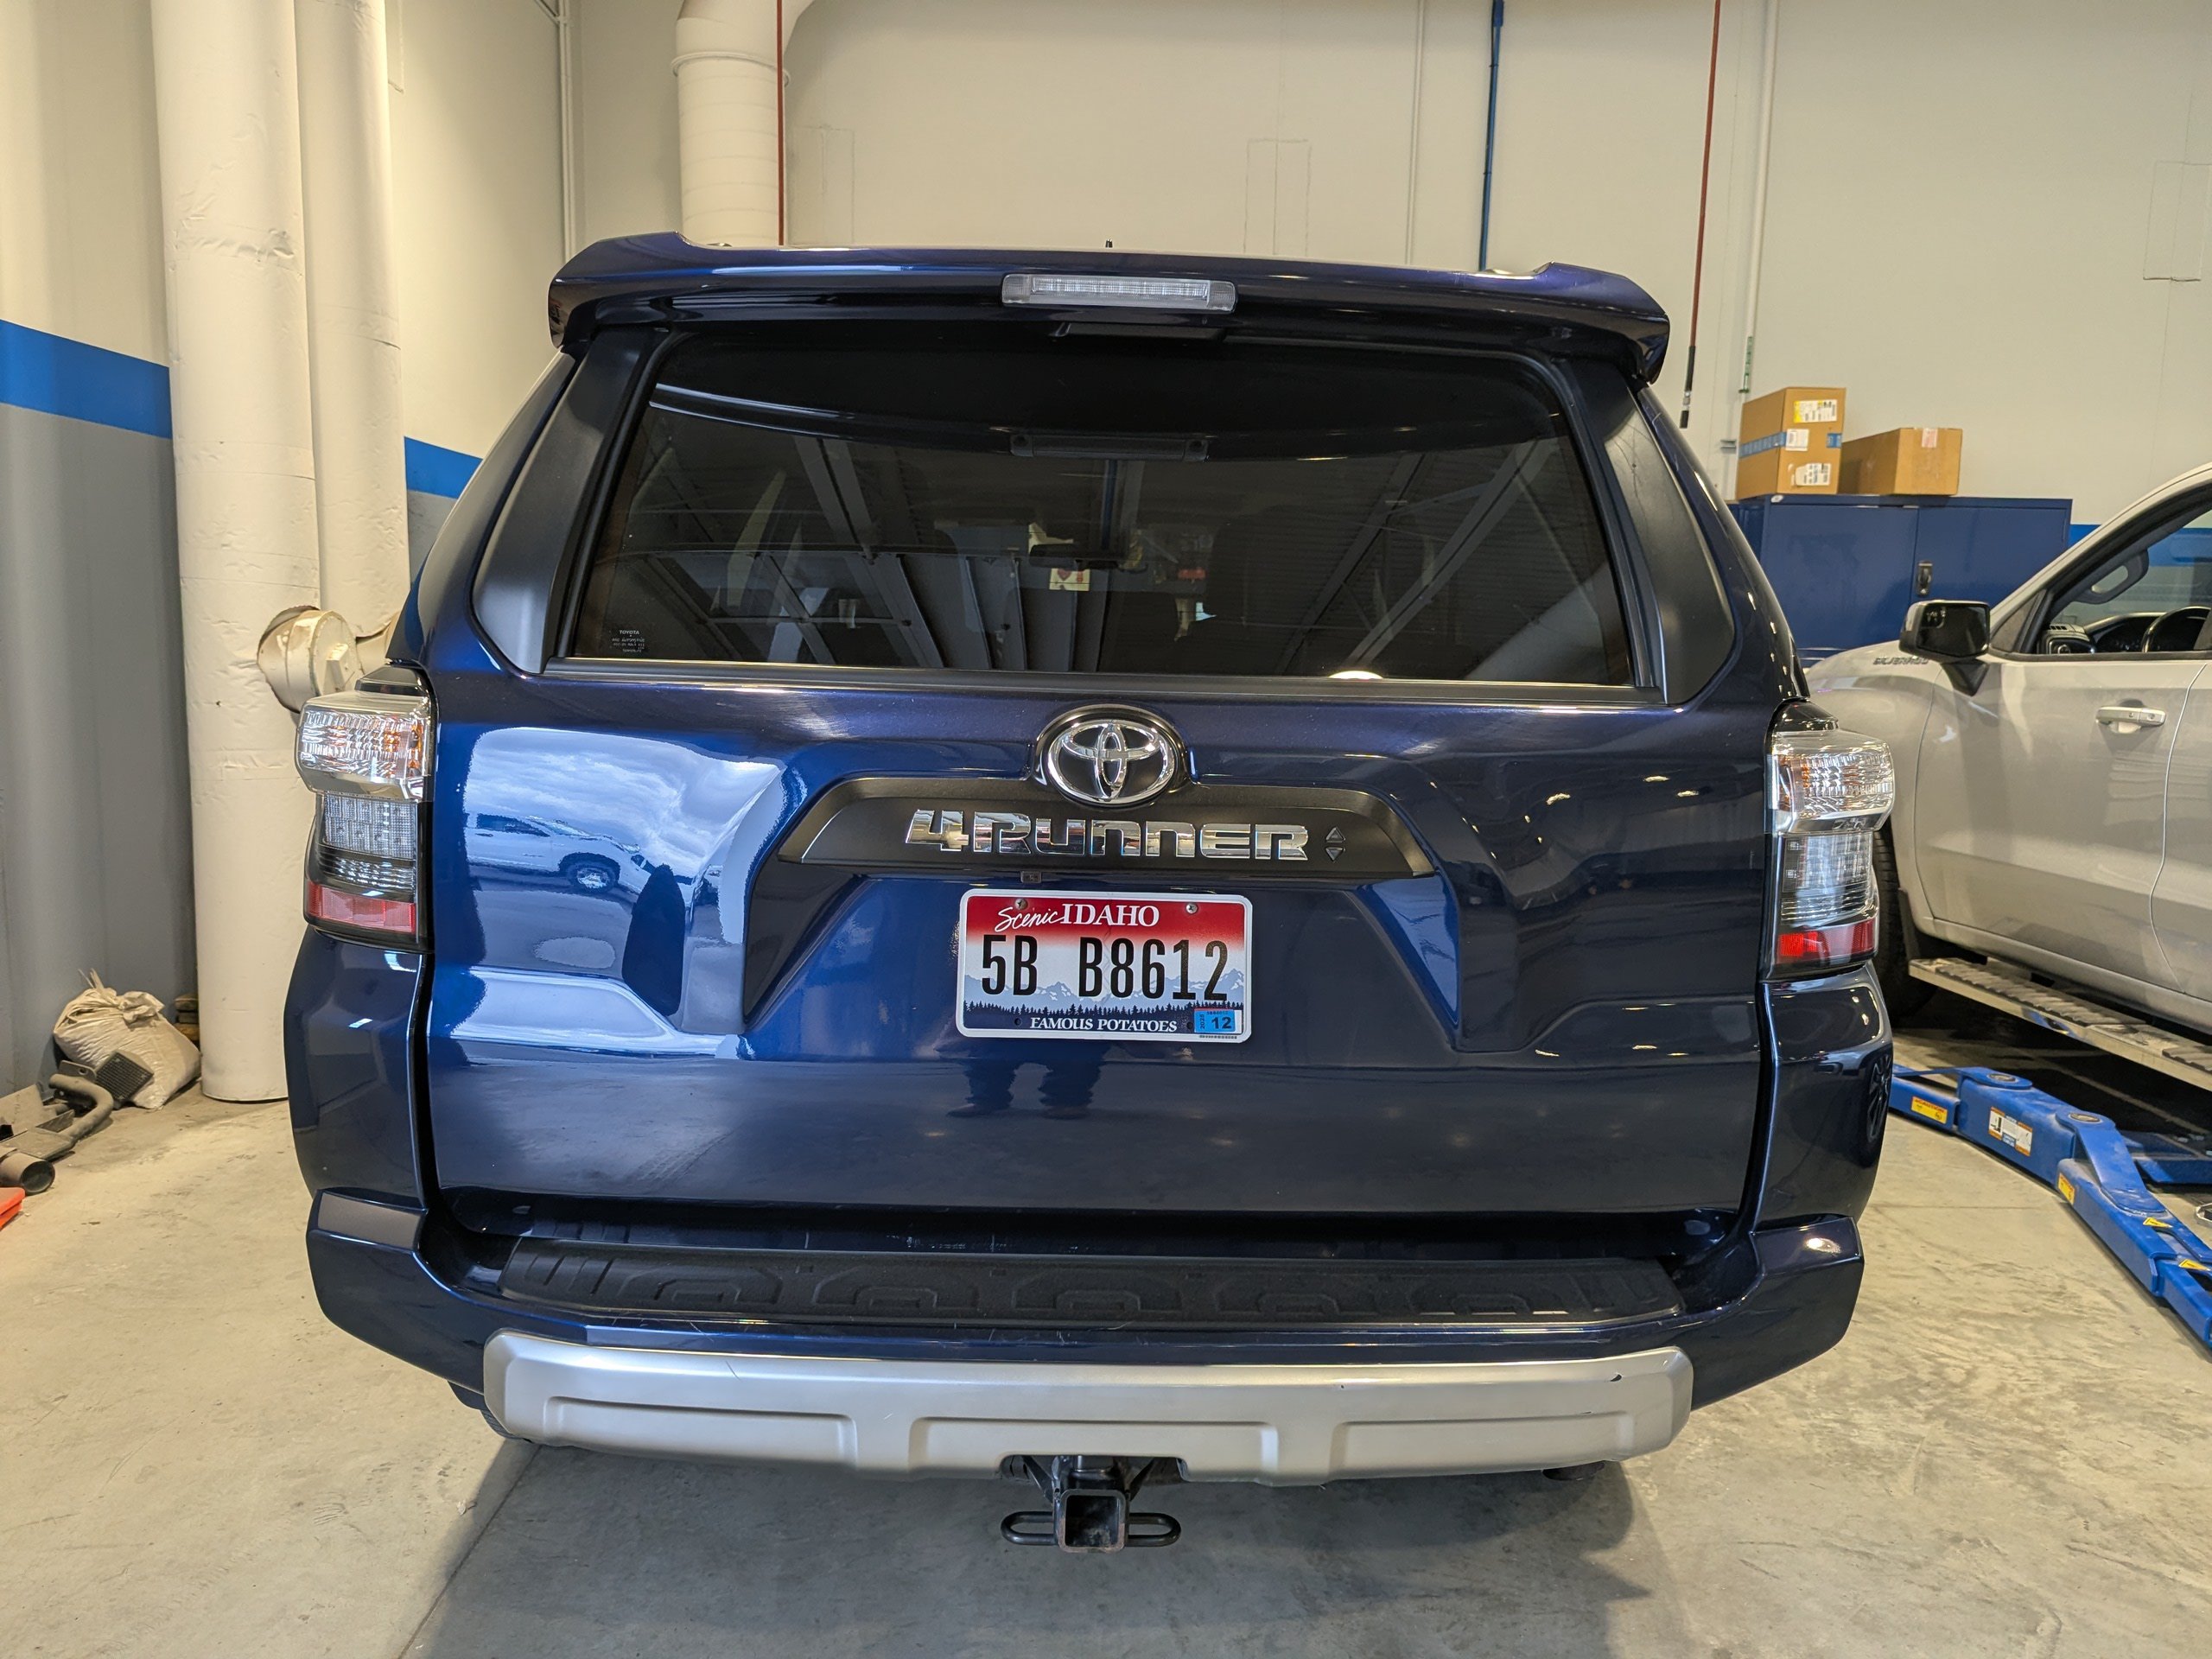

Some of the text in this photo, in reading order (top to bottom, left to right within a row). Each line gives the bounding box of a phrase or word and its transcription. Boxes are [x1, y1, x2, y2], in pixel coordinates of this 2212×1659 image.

[995, 903, 1160, 932] Scenic IDAHO
[982, 934, 1228, 1001] 5B B8612
[1030, 1017, 1178, 1033] FAMOUS POTATOES
[1211, 1016, 1232, 1029] 12
